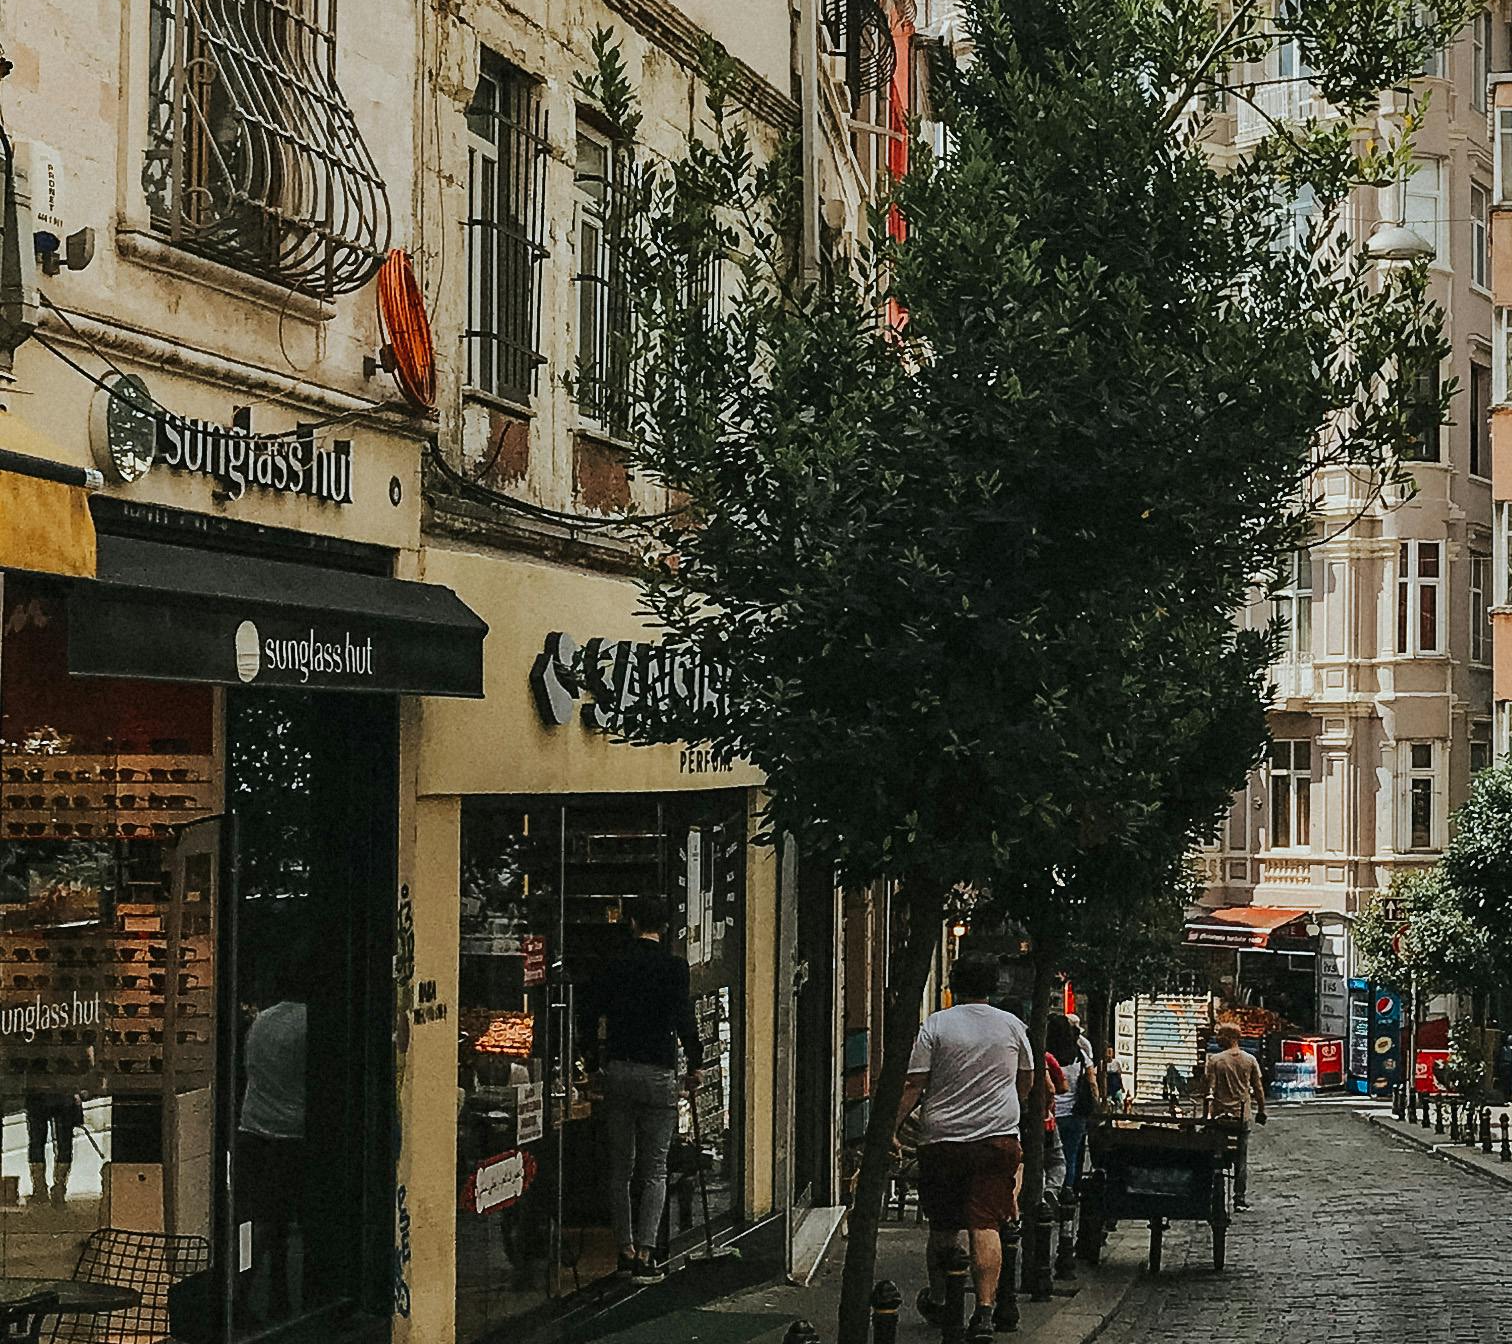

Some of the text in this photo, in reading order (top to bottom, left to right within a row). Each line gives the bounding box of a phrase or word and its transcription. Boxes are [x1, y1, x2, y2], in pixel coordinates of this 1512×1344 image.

[164, 407, 303, 502] sunglass
[265, 628, 373, 683] sunglass hut
[678, 750, 734, 774] PERFU
[0, 990, 101, 1043] unglass hut
